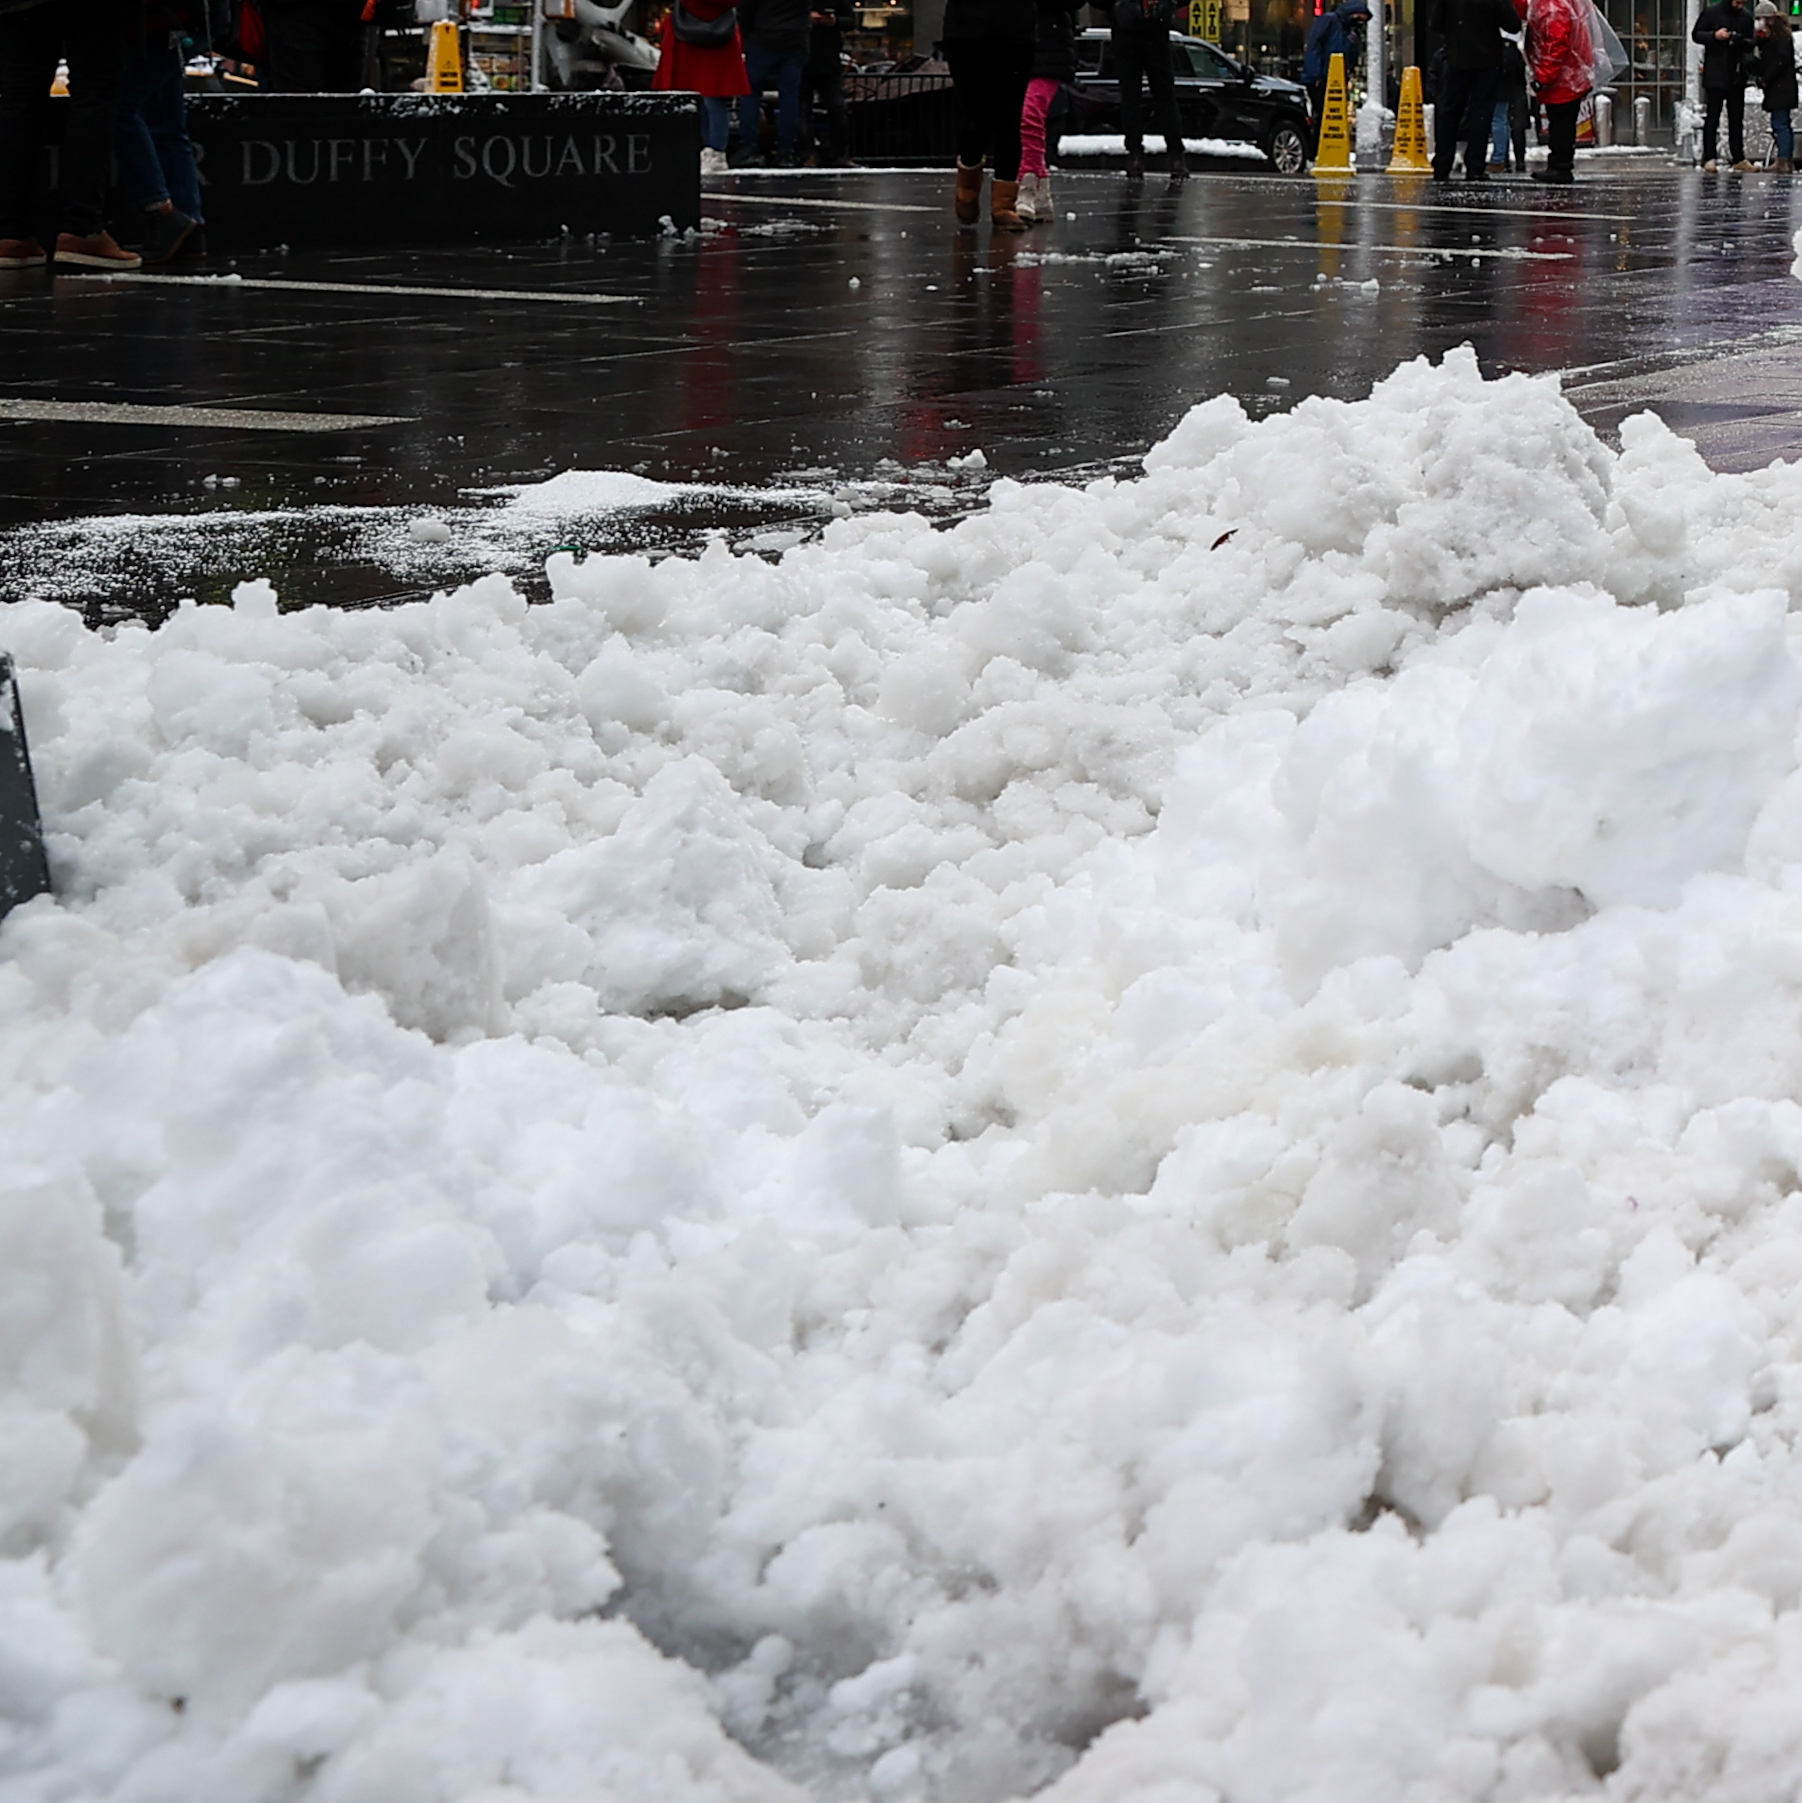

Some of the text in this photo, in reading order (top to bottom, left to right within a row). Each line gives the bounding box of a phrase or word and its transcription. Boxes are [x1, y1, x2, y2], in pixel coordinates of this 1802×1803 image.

[1192, 2, 1217, 38] ATM ATM
[241, 136, 429, 186] DUFFY
[453, 134, 654, 187] SQUARE
